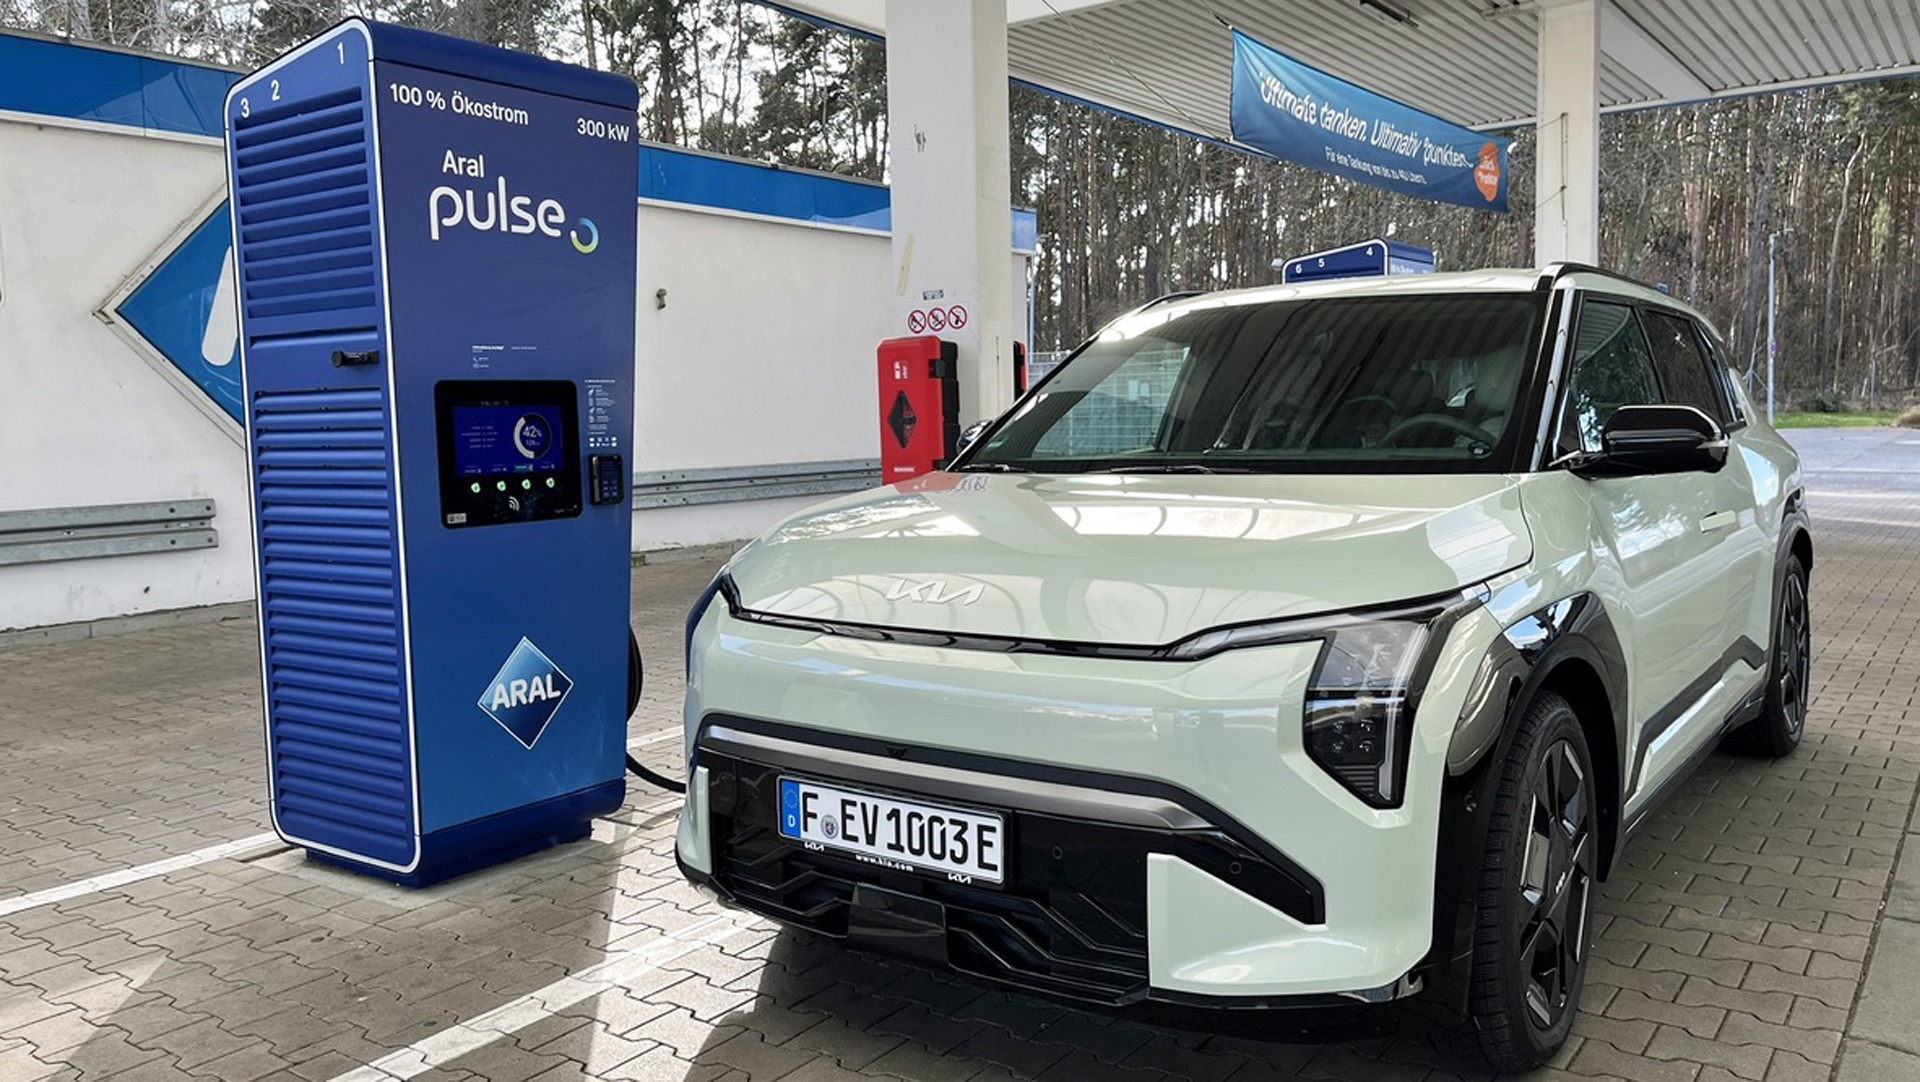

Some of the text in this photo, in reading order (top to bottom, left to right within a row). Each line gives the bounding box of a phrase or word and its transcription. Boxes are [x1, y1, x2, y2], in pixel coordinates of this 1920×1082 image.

[336, 42, 345, 65] 1
[271, 79, 280, 101] 2
[240, 98, 250, 119] 3
[390, 82, 529, 126] 100 % Ökostrom
[1260, 72, 1317, 125] Ultimate
[1320, 102, 1367, 142] tanken.
[1371, 118, 1422, 158] Ultimativ
[577, 118, 630, 142] 300 kW
[442, 150, 485, 178] Aral
[429, 175, 567, 241] pulse
[1366, 246, 1373, 256] 4
[1295, 263, 1303, 274] 6
[1318, 258, 1325, 268] 5
[884, 578, 987, 607] KIA
[491, 673, 561, 712] ARAL
[788, 814, 796, 828] D
[802, 792, 819, 833] F
[855, 854, 914, 873] www.kia.com
